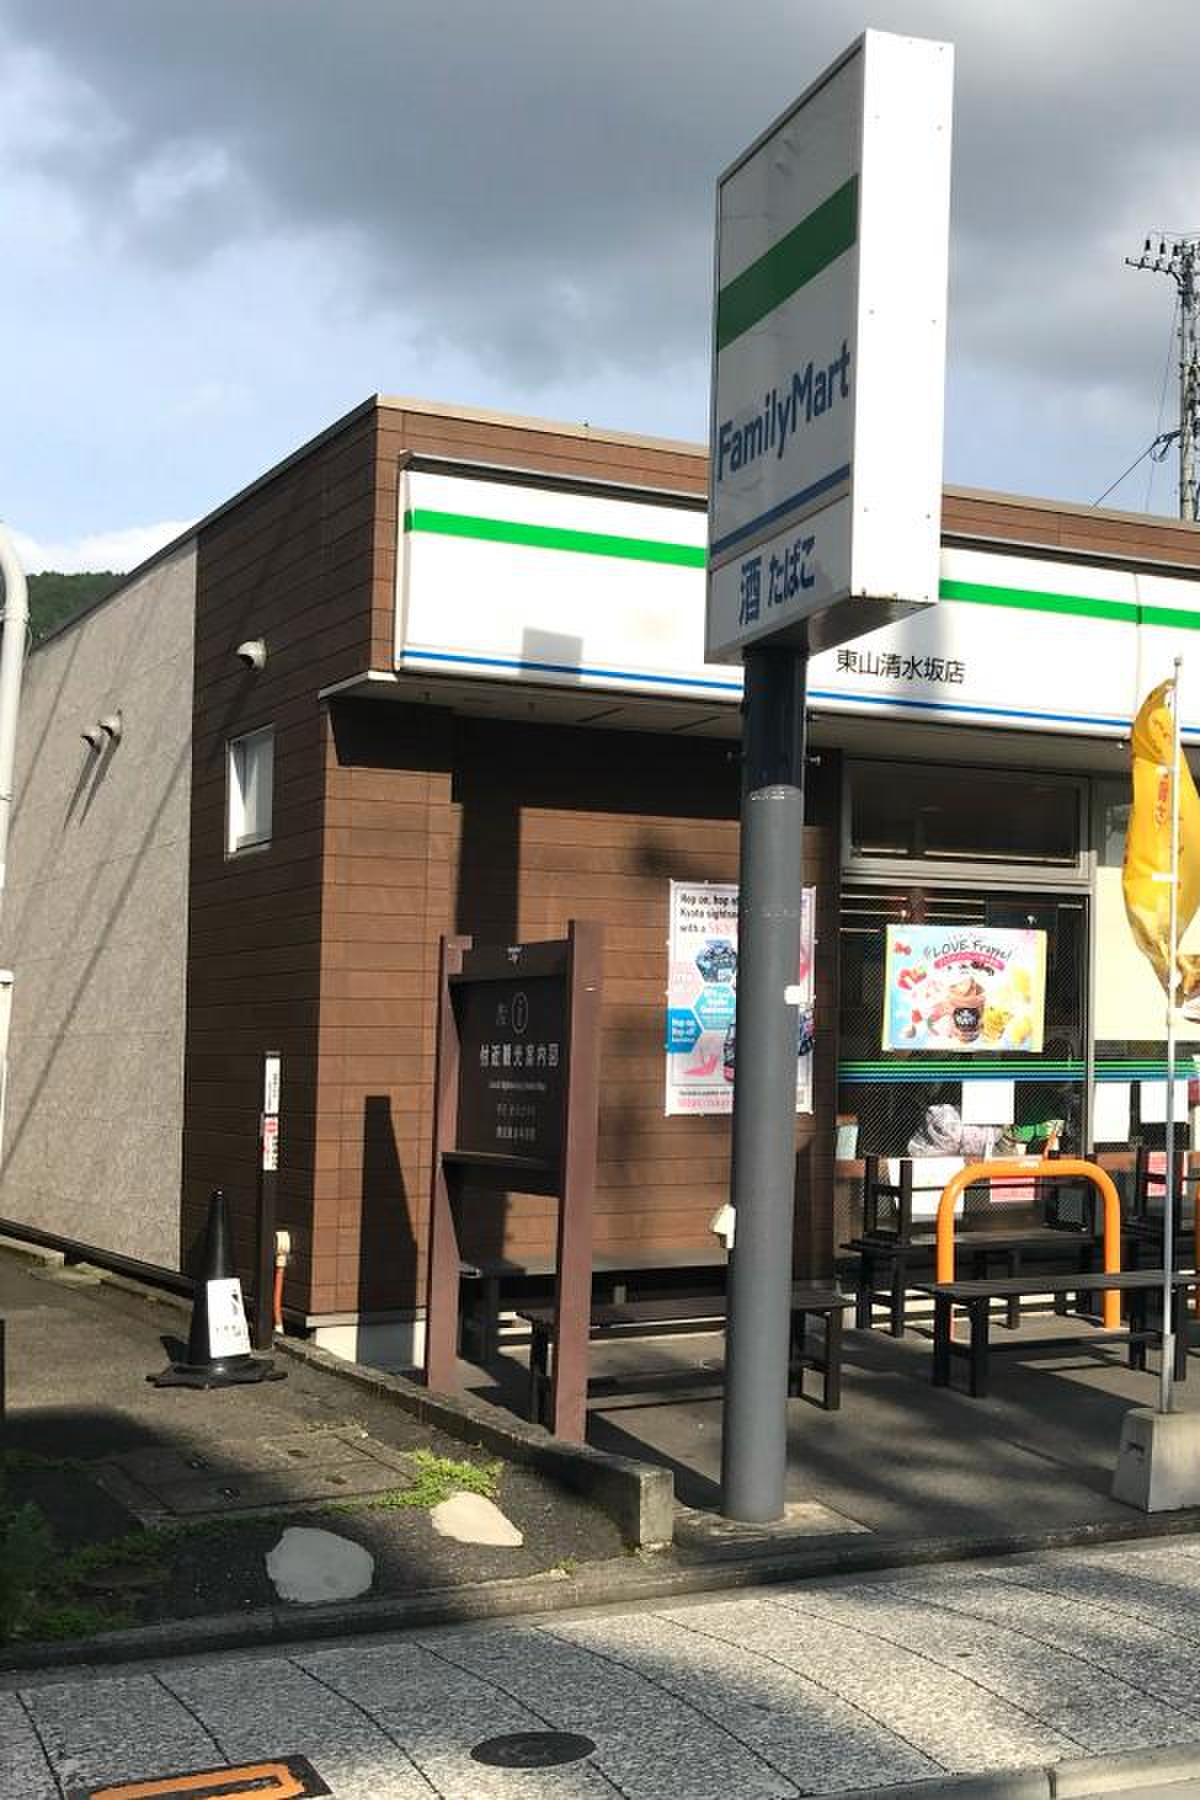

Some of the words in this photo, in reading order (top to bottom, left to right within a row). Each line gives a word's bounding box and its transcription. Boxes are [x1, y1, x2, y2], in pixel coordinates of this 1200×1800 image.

[717, 341, 850, 480] FamilyMart
[739, 556, 762, 625] 酒
[768, 535, 816, 607] たばこ
[836, 648, 966, 685] 東山清水坂店
